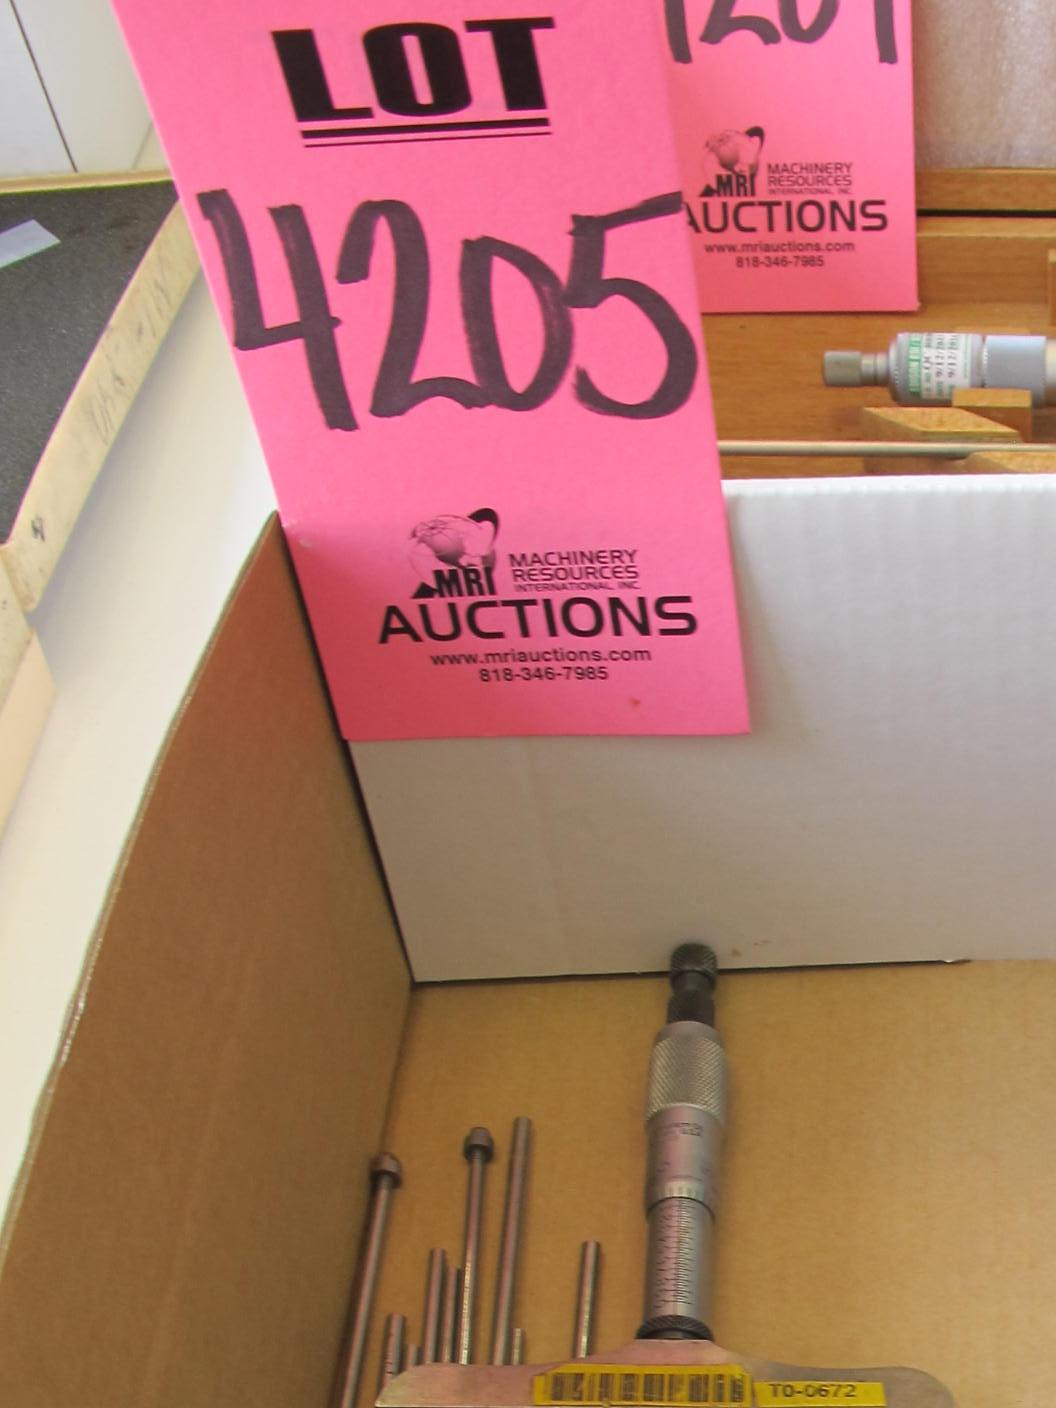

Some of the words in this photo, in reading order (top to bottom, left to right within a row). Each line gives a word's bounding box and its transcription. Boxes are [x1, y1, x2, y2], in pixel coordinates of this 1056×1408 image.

[271, 17, 555, 122] LOT
[767, 162, 853, 174] MACHINERY
[716, 173, 756, 197] MRI
[767, 175, 853, 187] RESOURCES
[704, 240, 855, 253] www.mriauctions.com
[736, 256, 825, 268] 818-346-7985
[196, 189, 700, 431] 4205
[508, 549, 638, 567] MACHINERY
[433, 566, 497, 598] MRI
[512, 565, 640, 582] RESOURCES
[378, 596, 698, 644] AUCTIONS
[430, 648, 652, 666] www.mriauctions.com
[480, 666, 609, 682] 818-346-7985
